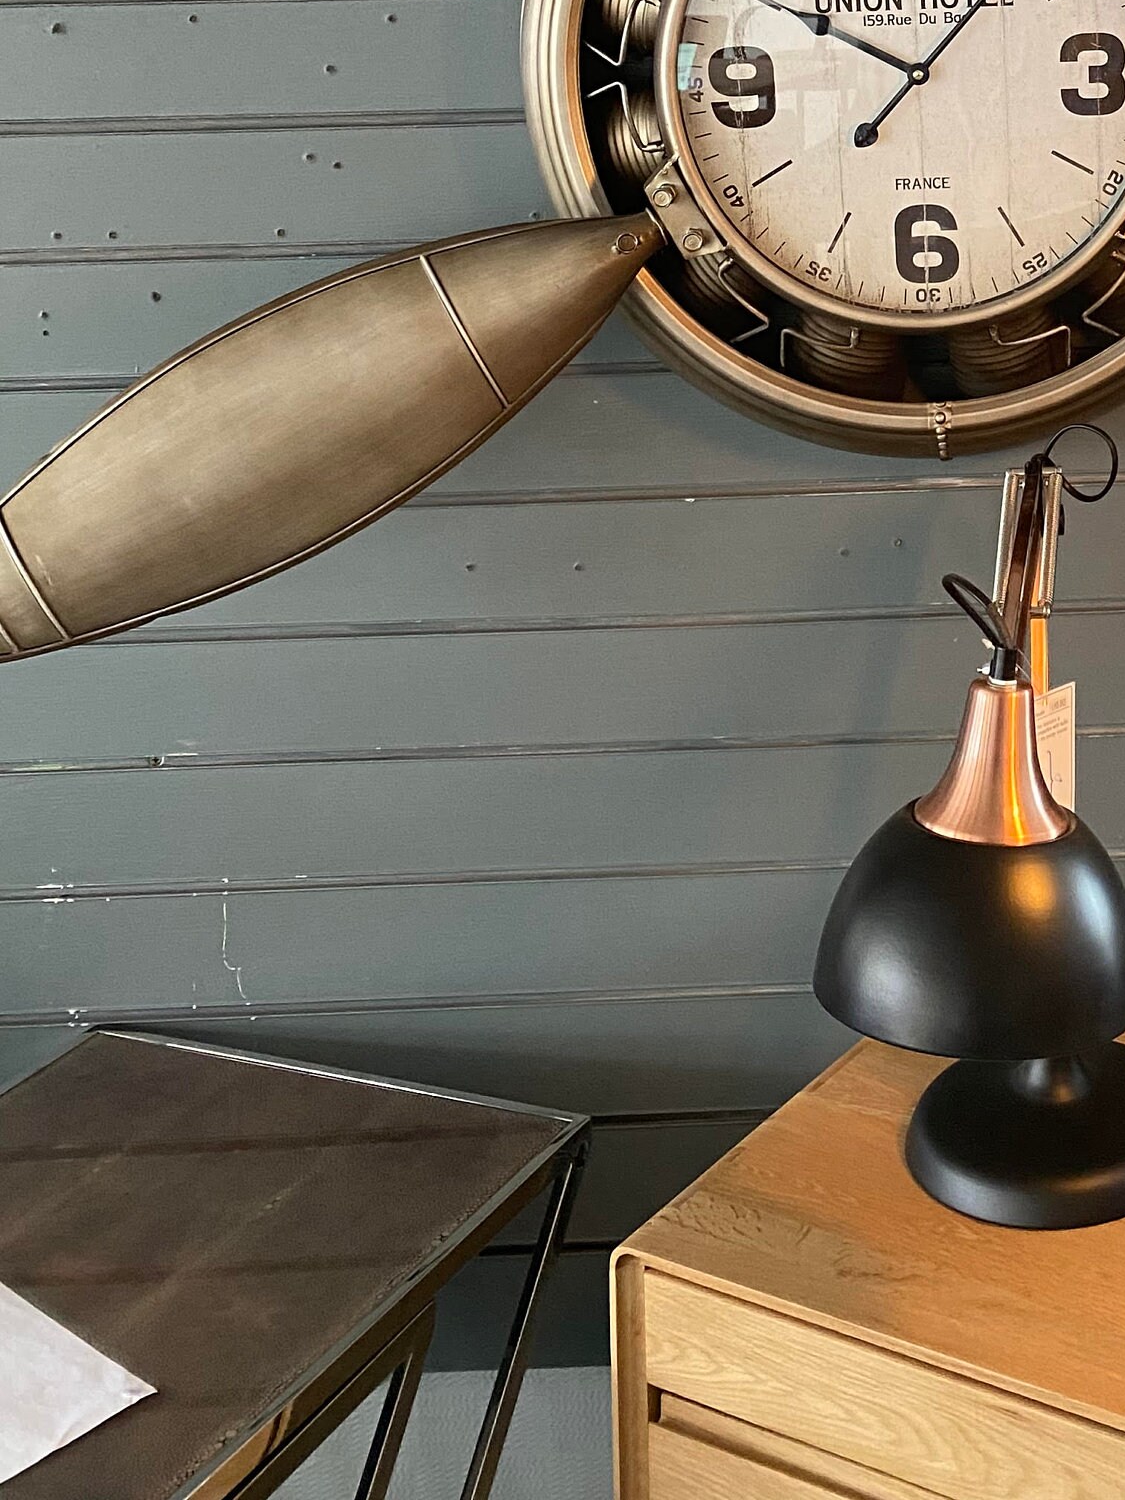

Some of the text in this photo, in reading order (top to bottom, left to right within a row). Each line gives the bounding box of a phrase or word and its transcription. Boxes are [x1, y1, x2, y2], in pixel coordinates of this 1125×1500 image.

[863, 13, 912, 27] 159.Rue
[919, 12, 937, 25] Du
[688, 77, 704, 102] 45
[708, 46, 776, 128] 9
[895, 177, 950, 190] FRANCE
[1102, 170, 1124, 195] 20
[723, 184, 745, 207] 40
[894, 203, 960, 284] 6
[805, 260, 832, 282] 35
[1022, 252, 1048, 274] 25
[915, 288, 941, 303] 30
